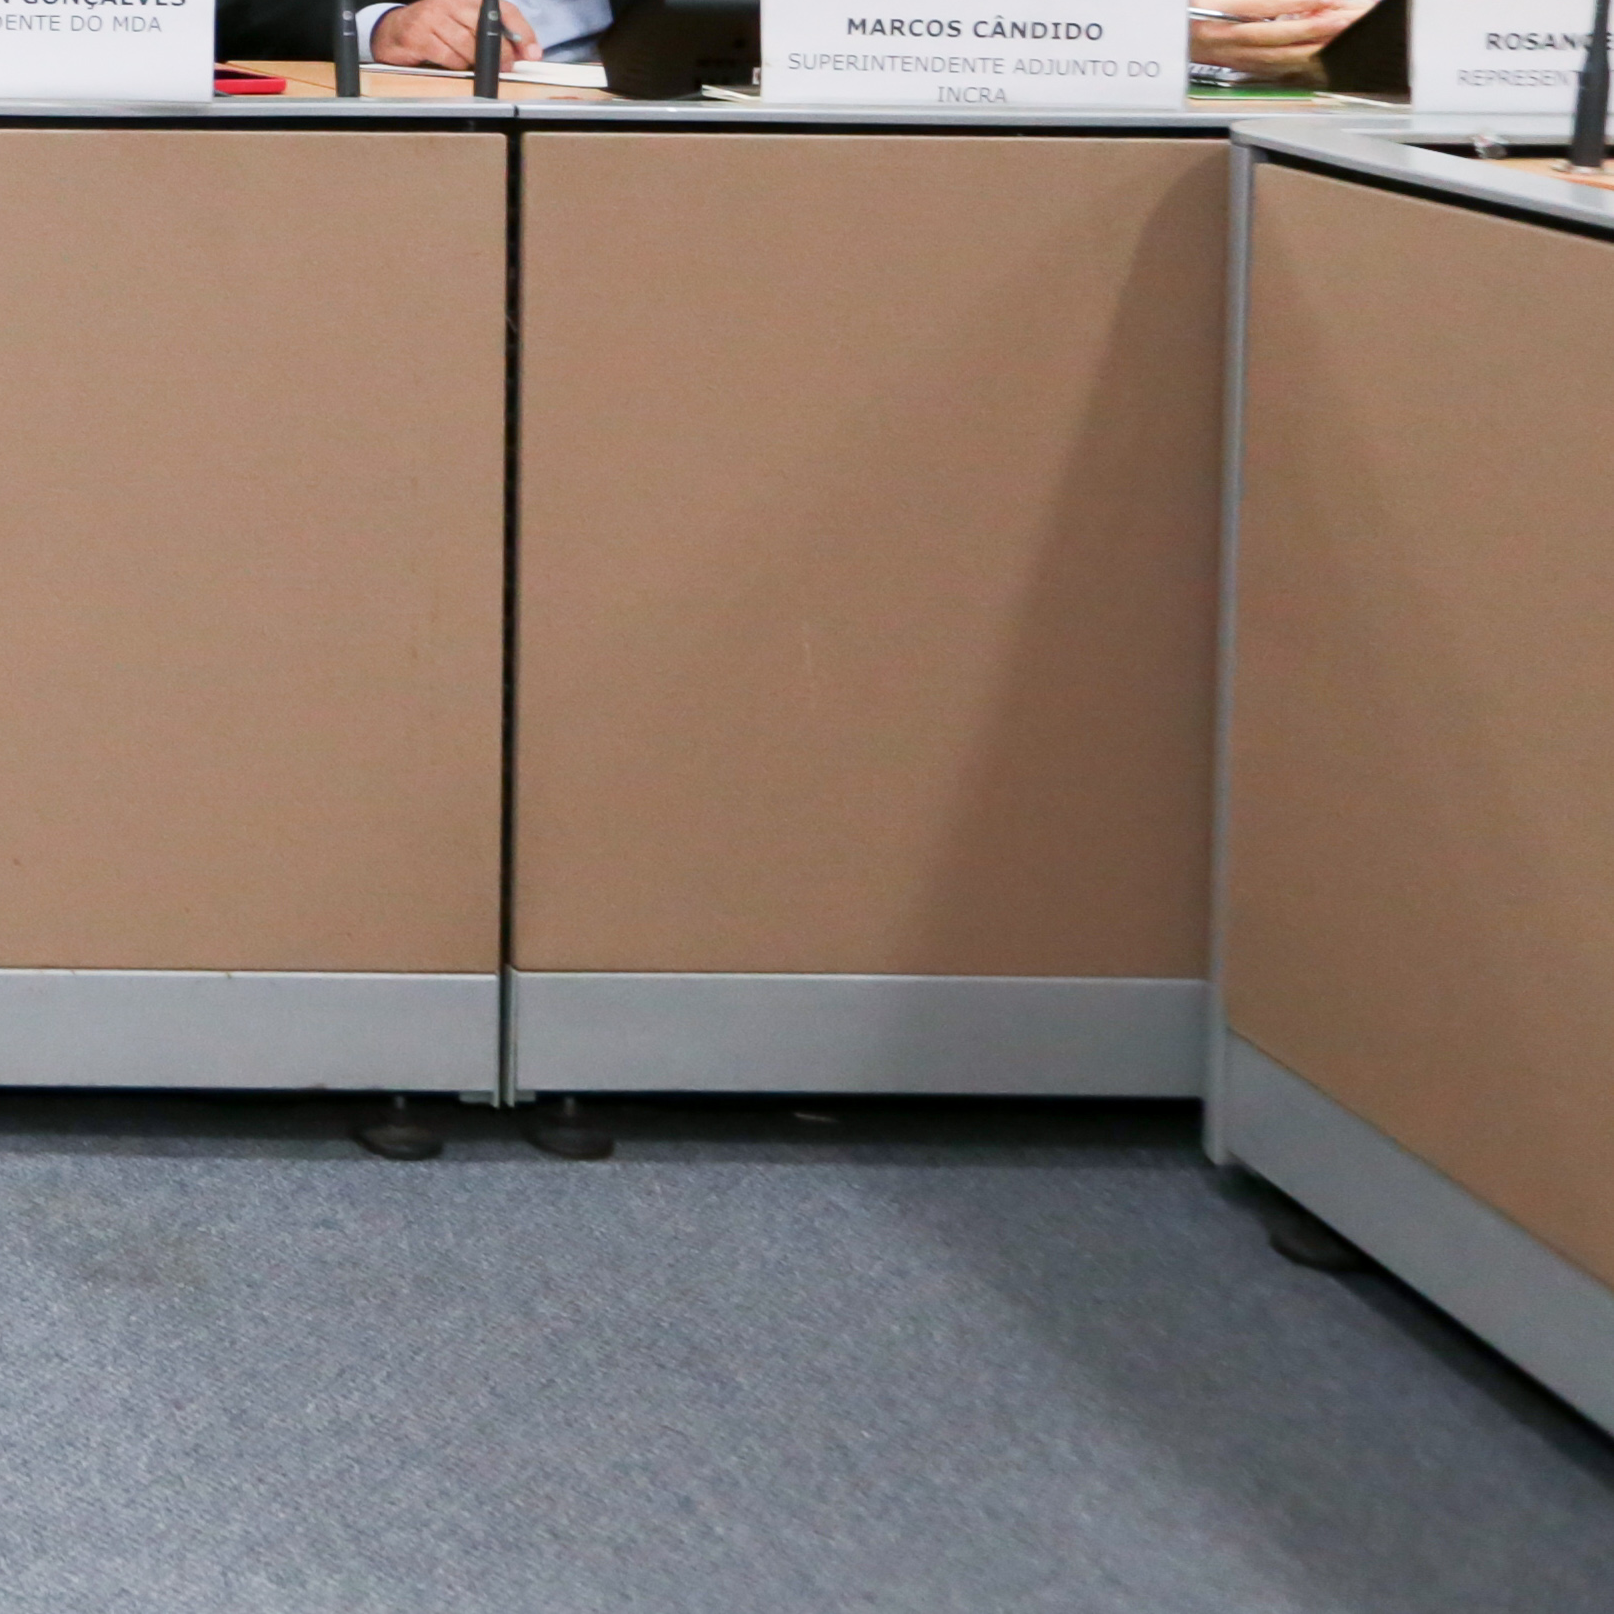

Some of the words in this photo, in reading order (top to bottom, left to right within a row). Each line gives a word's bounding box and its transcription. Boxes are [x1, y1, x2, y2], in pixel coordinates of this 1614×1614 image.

[70, 14, 103, 33] DO
[112, 15, 162, 33] MDA
[847, 17, 962, 38] MARCOS
[972, 14, 1103, 41] CÂNDIDO
[1487, 32, 1612, 52] ROSAN
[788, 52, 1005, 75] SUPERINTENDENTE
[1012, 58, 1118, 78] ADJUNTO
[1127, 60, 1161, 79] DO
[1458, 69, 1578, 87] REPRESEN
[937, 85, 1008, 104] INCRA
